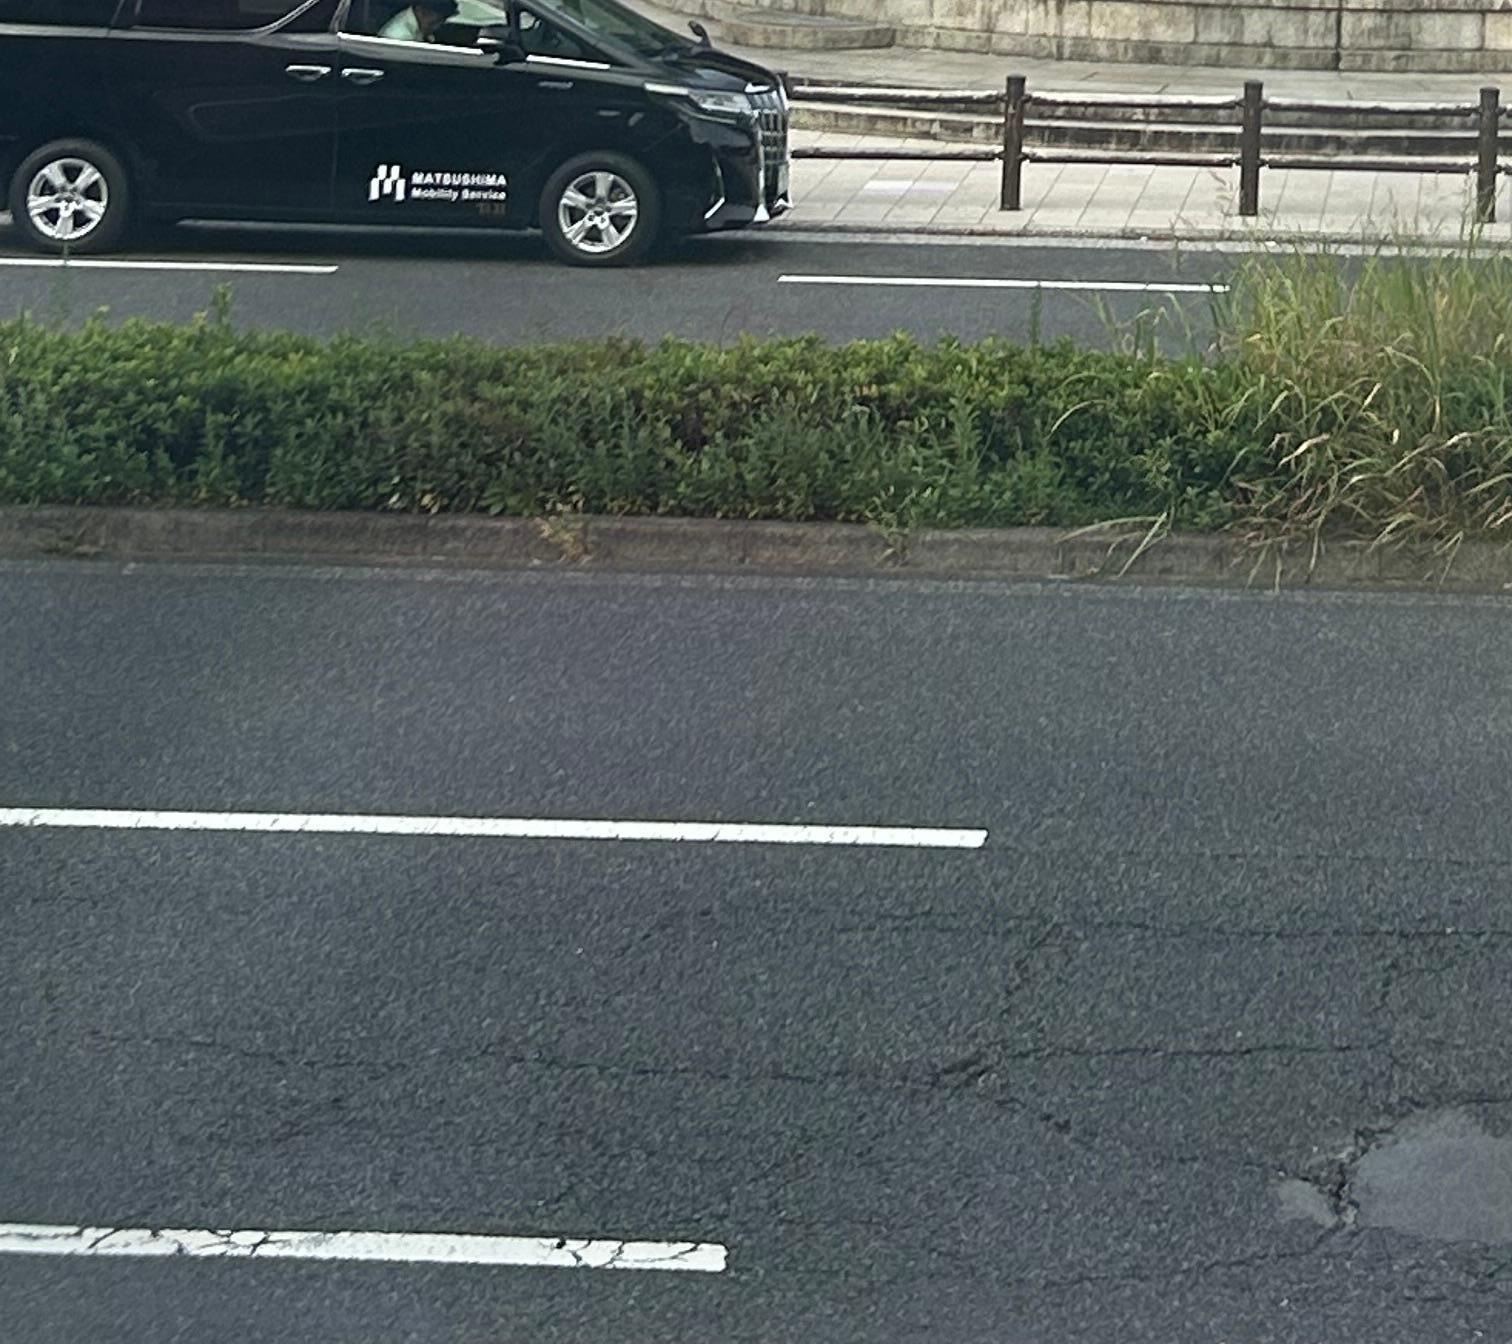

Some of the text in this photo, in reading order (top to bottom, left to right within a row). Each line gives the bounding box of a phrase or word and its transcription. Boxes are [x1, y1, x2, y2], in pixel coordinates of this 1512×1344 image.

[411, 172, 507, 185] MATSUSHIMA
[411, 187, 507, 202] Mobility Service
